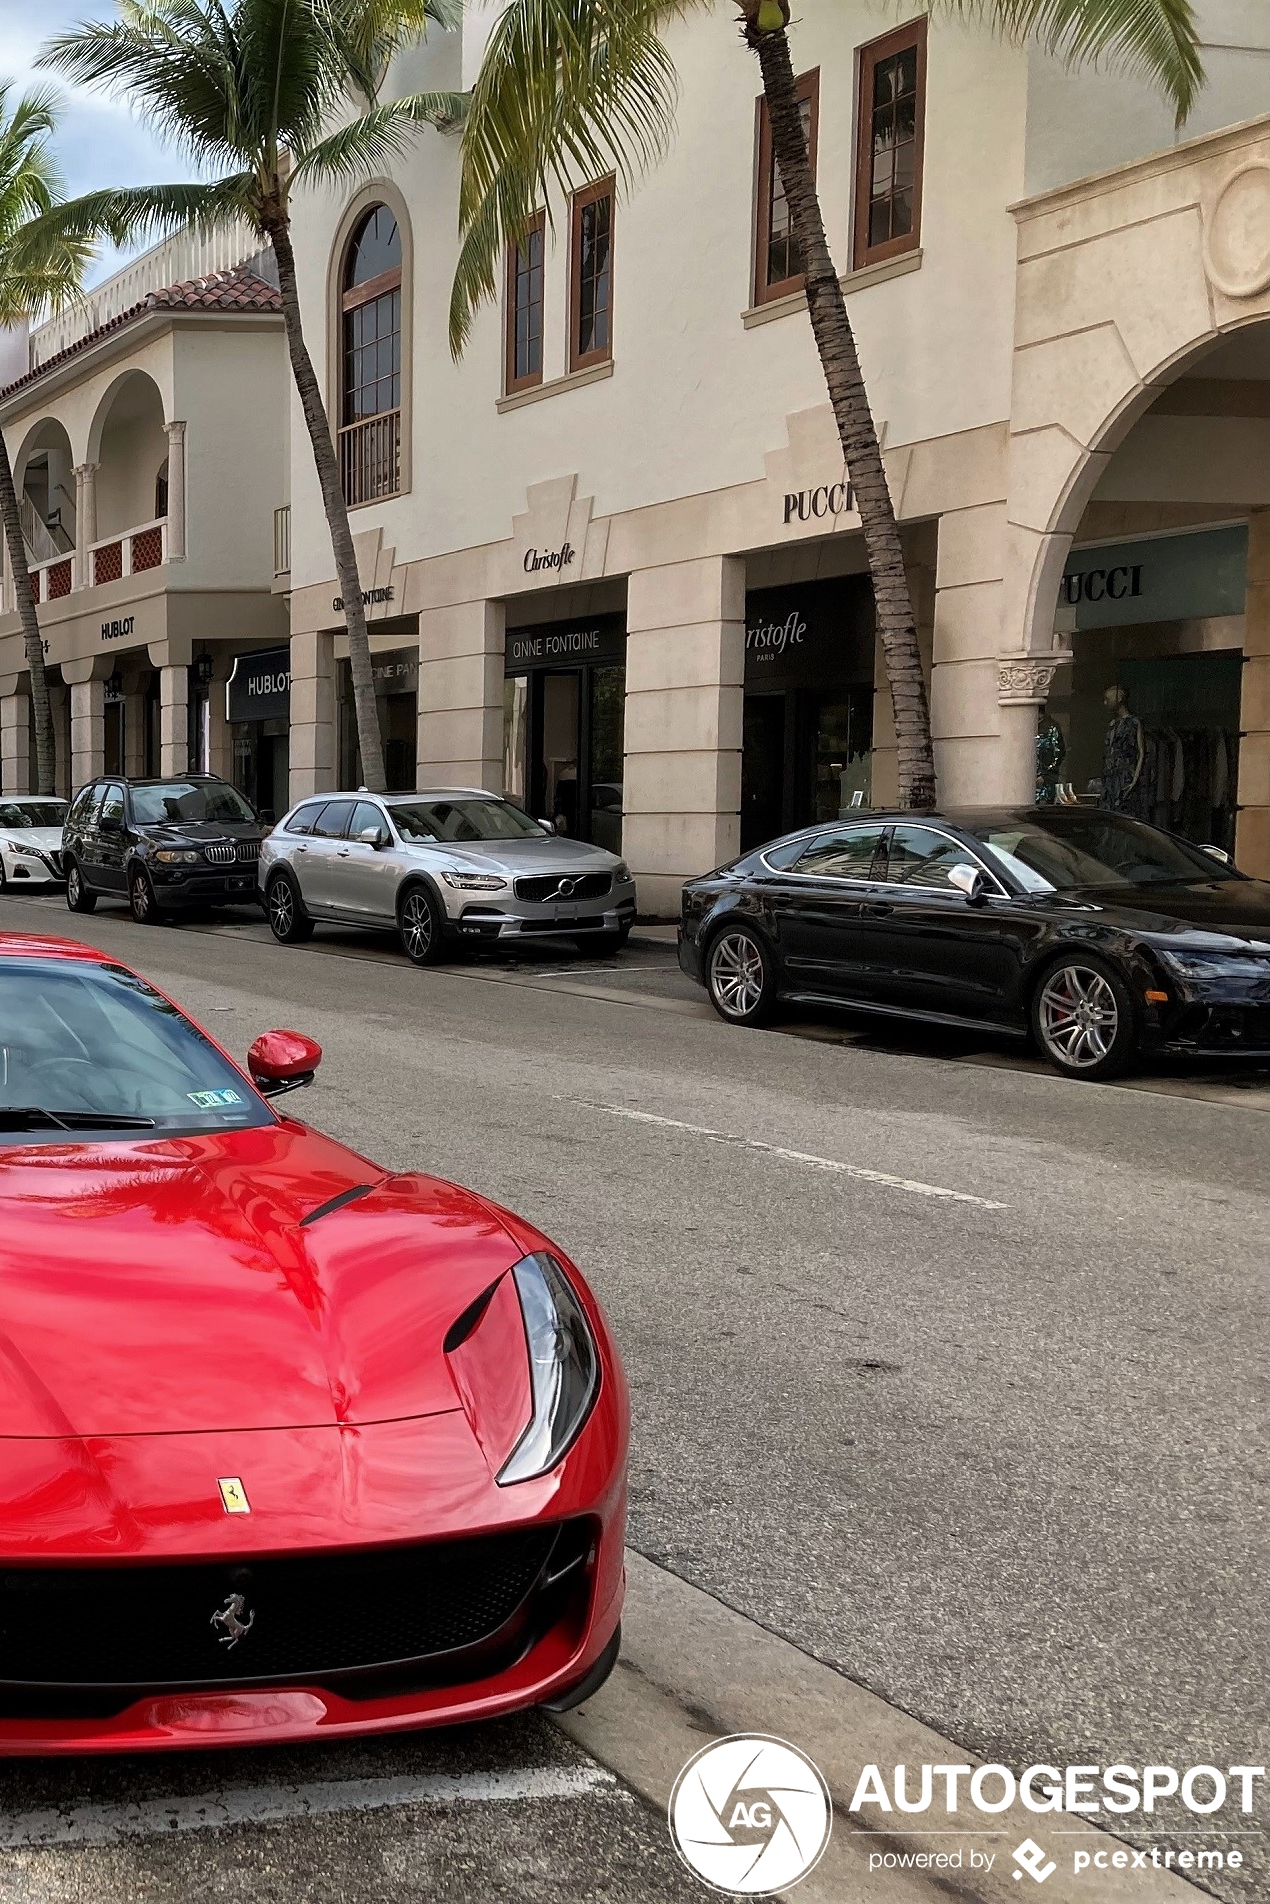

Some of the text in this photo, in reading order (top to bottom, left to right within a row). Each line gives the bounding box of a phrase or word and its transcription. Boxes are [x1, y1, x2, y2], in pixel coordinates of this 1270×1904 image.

[783, 481, 853, 524] PUCCI
[524, 543, 575, 572] Christofle
[1064, 565, 1144, 604] UCCI
[101, 616, 134, 640] HUBLOT
[746, 612, 806, 653] ristofle
[756, 654, 774, 662] PARIS
[248, 672, 290, 696] HUBLOT
